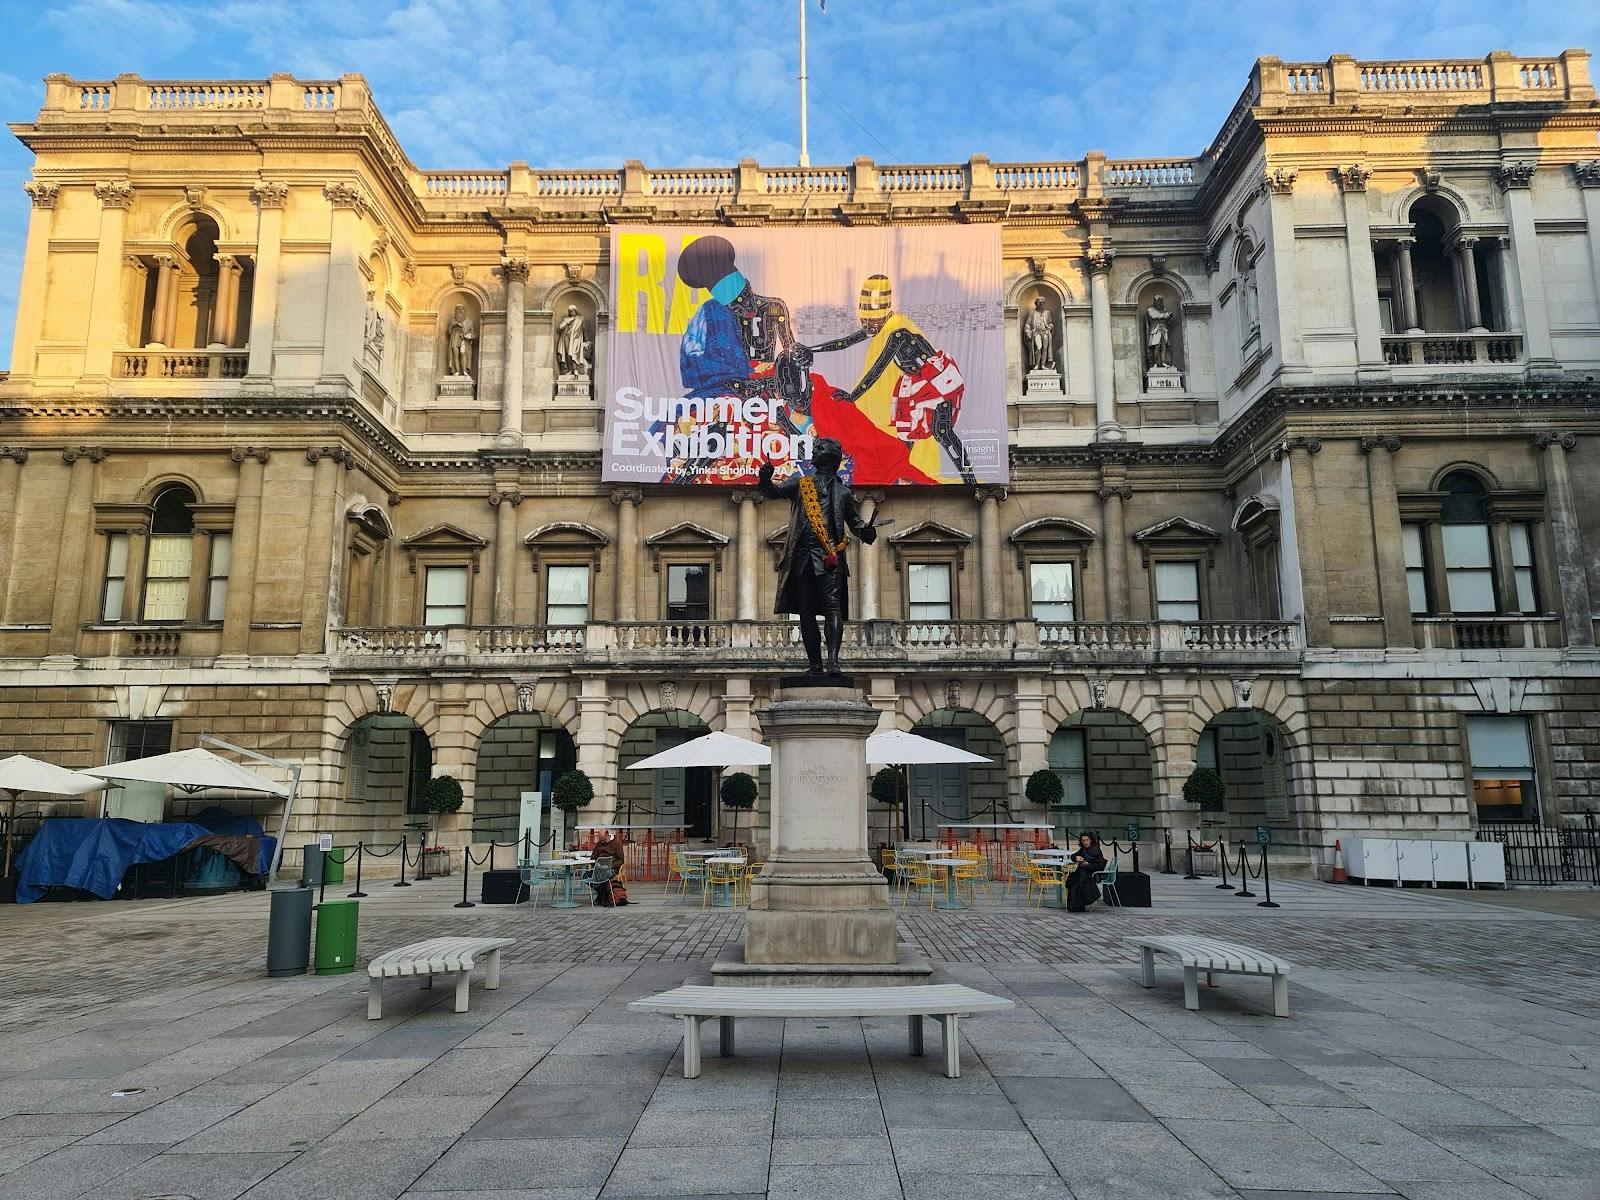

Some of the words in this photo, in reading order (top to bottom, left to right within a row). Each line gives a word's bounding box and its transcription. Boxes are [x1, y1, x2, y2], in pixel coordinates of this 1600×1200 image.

[612, 386, 784, 423] Summer
[611, 421, 814, 460] Exhibition
[966, 444, 995, 455] Insight
[611, 462, 673, 474] Coordinated
[674, 465, 687, 477] by
[689, 465, 717, 475] Yinka
[719, 465, 760, 476] Shoniba
